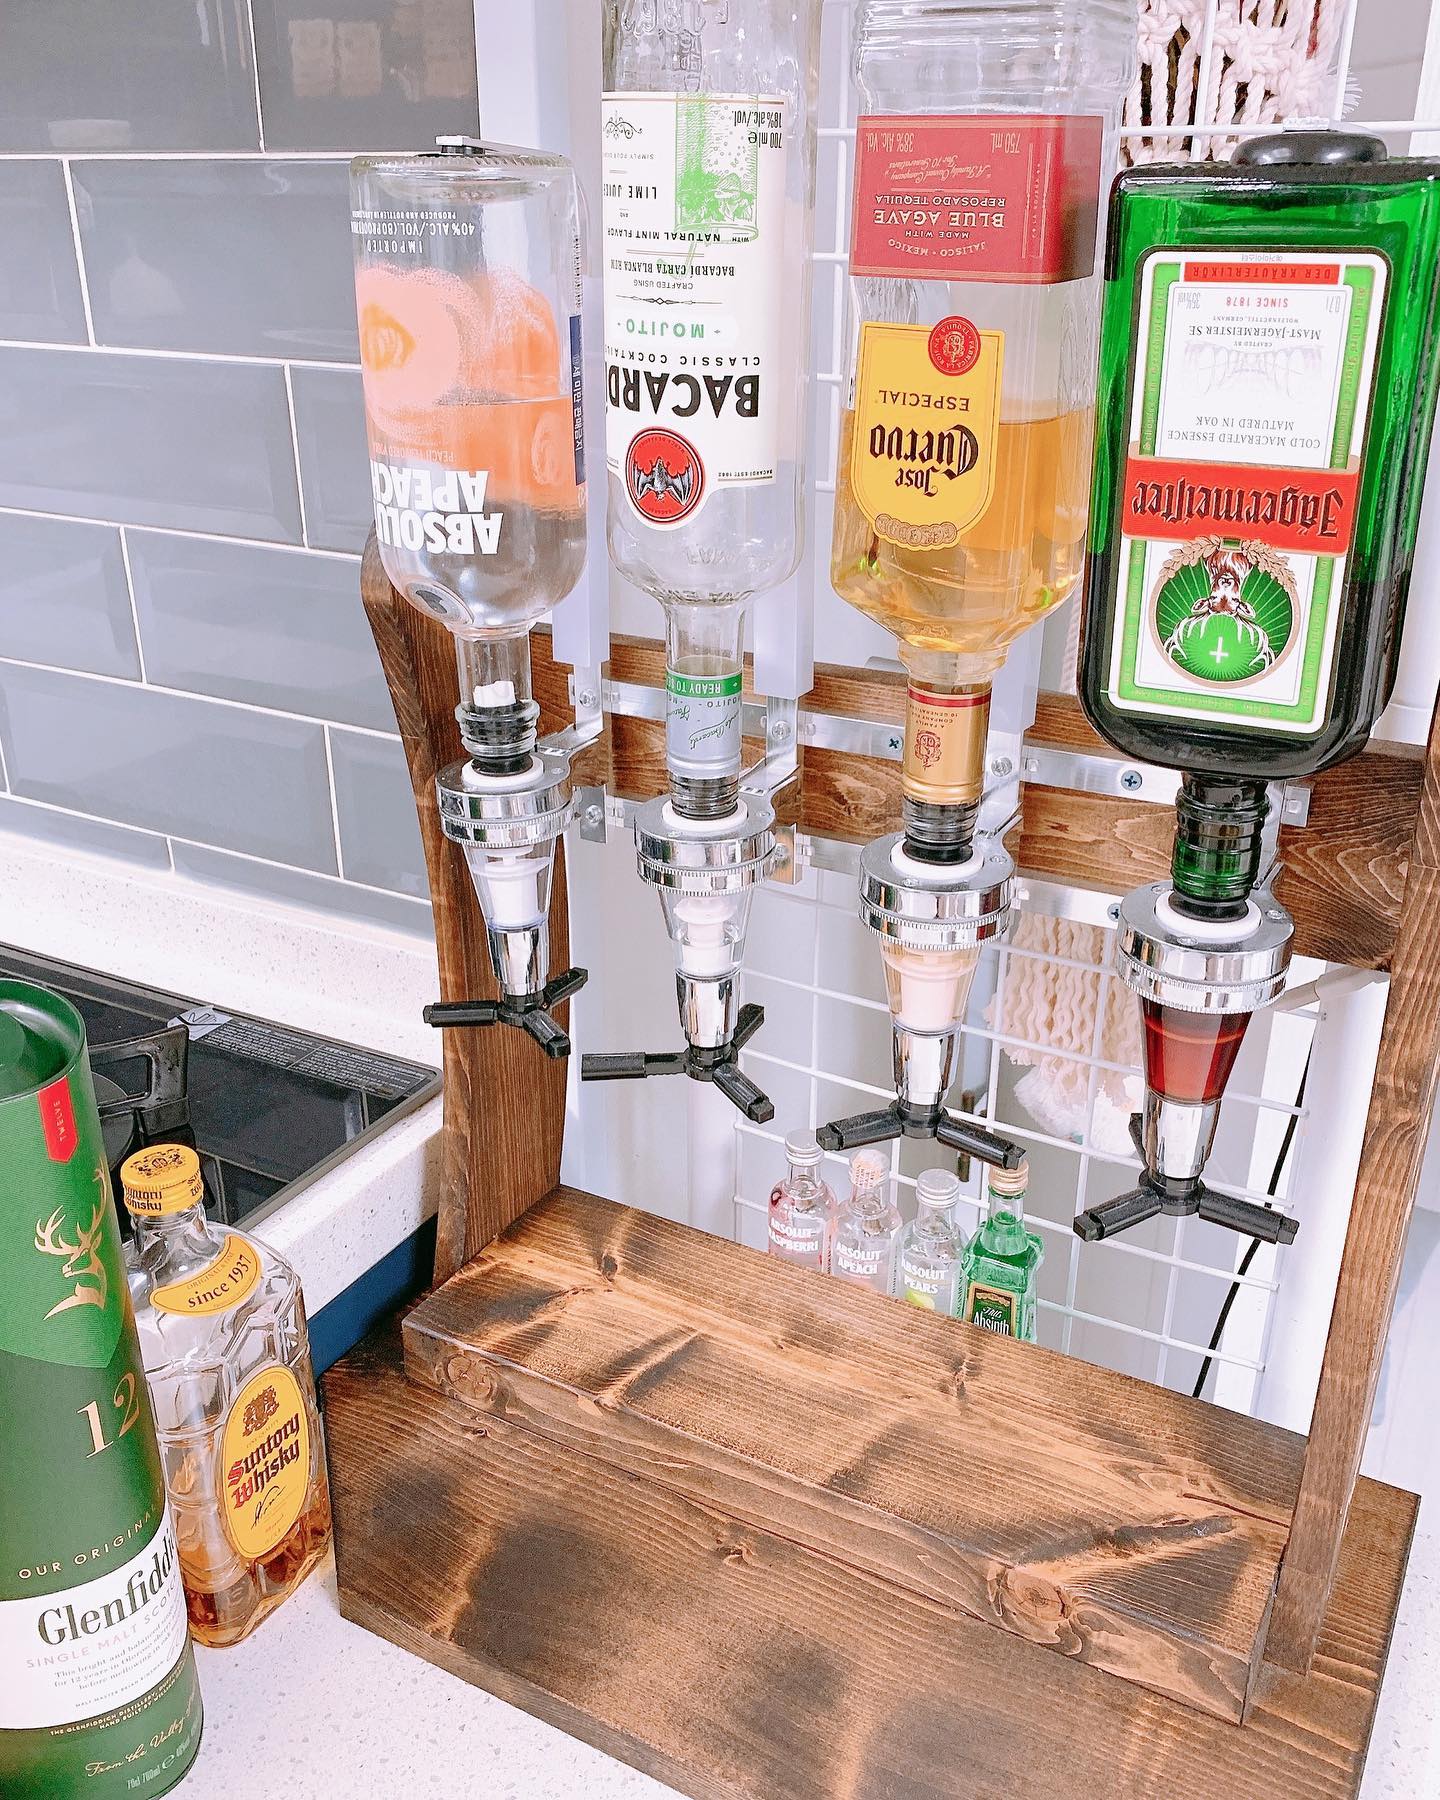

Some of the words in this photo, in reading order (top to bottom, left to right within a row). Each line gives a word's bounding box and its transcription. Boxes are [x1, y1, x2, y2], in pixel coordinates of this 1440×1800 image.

[767, 111, 782, 128] 18%
[770, 132, 782, 148] 700
[896, 132, 914, 152] 38%
[1005, 133, 1020, 153] 750
[628, 186, 656, 199] LIME
[875, 195, 928, 205] TEQUILA
[932, 197, 1005, 206] REPOSADO
[874, 209, 941, 226] AGAVE
[948, 211, 1005, 228] BLUE
[452, 223, 475, 235] 40%
[636, 230, 659, 240] MINT
[905, 230, 933, 238] WITH
[938, 231, 970, 239] MADE
[664, 232, 720, 242] NATURAL
[367, 240, 423, 253] IMPORTED
[888, 239, 928, 256] MEXICO
[940, 241, 985, 257] JALISCO
[624, 260, 652, 272] BLANCA
[656, 264, 686, 275] CARTA
[1192, 267, 1296, 280] KRÄUTERLIKÖR
[1305, 268, 1331, 280] DER
[633, 279, 654, 287] USING
[657, 281, 693, 289] CRAFTED
[1226, 297, 1250, 306] 1878
[1257, 298, 1288, 308] SINCE
[626, 319, 704, 338] MOJITO
[1188, 325, 1203, 336] SE
[1206, 326, 1321, 340] MAST-JÄGERMEISTER
[680, 356, 760, 366] CLASSIC
[878, 390, 970, 412] ESPECIAL
[1195, 416, 1218, 427] OAK
[1221, 417, 1234, 428] IN
[1238, 417, 1294, 431] MATURED
[1167, 430, 1215, 442] ESSENCE
[1218, 433, 1286, 447] MACERATED
[1289, 437, 1321, 449] COLD
[869, 423, 979, 481] Cuervo
[895, 466, 942, 498] Jose
[677, 681, 686, 693] TO
[689, 683, 721, 694] READY
[837, 1242, 882, 1261] ABSOLUT
[838, 1257, 878, 1275] APEACH
[901, 1259, 948, 1280] ABSOLUT
[188, 1283, 230, 1308] since
[229, 1254, 252, 1284] 1937
[904, 1275, 938, 1294] PEARS
[77, 1373, 140, 1458] 12
[228, 1412, 301, 1488] Suntory
[231, 1438, 300, 1510] Whisky
[18, 1561, 62, 1580] OUR
[26, 1647, 90, 1669] SINGLE
[97, 1625, 138, 1652] MALT
[78, 1658, 106, 1672] bright
[109, 1648, 125, 1660] and
[79, 1677, 108, 1690] before
[110, 1654, 152, 1679] mellowing
[67, 1713, 117, 1733] GLENFIDDICH
[119, 1692, 158, 1716] DISTILLERY,
[100, 1719, 120, 1729] HAND
[123, 1708, 143, 1721] BUILT
[84, 1753, 124, 1777] From
[126, 1743, 148, 1768] the
[150, 1721, 184, 1747] Valley
